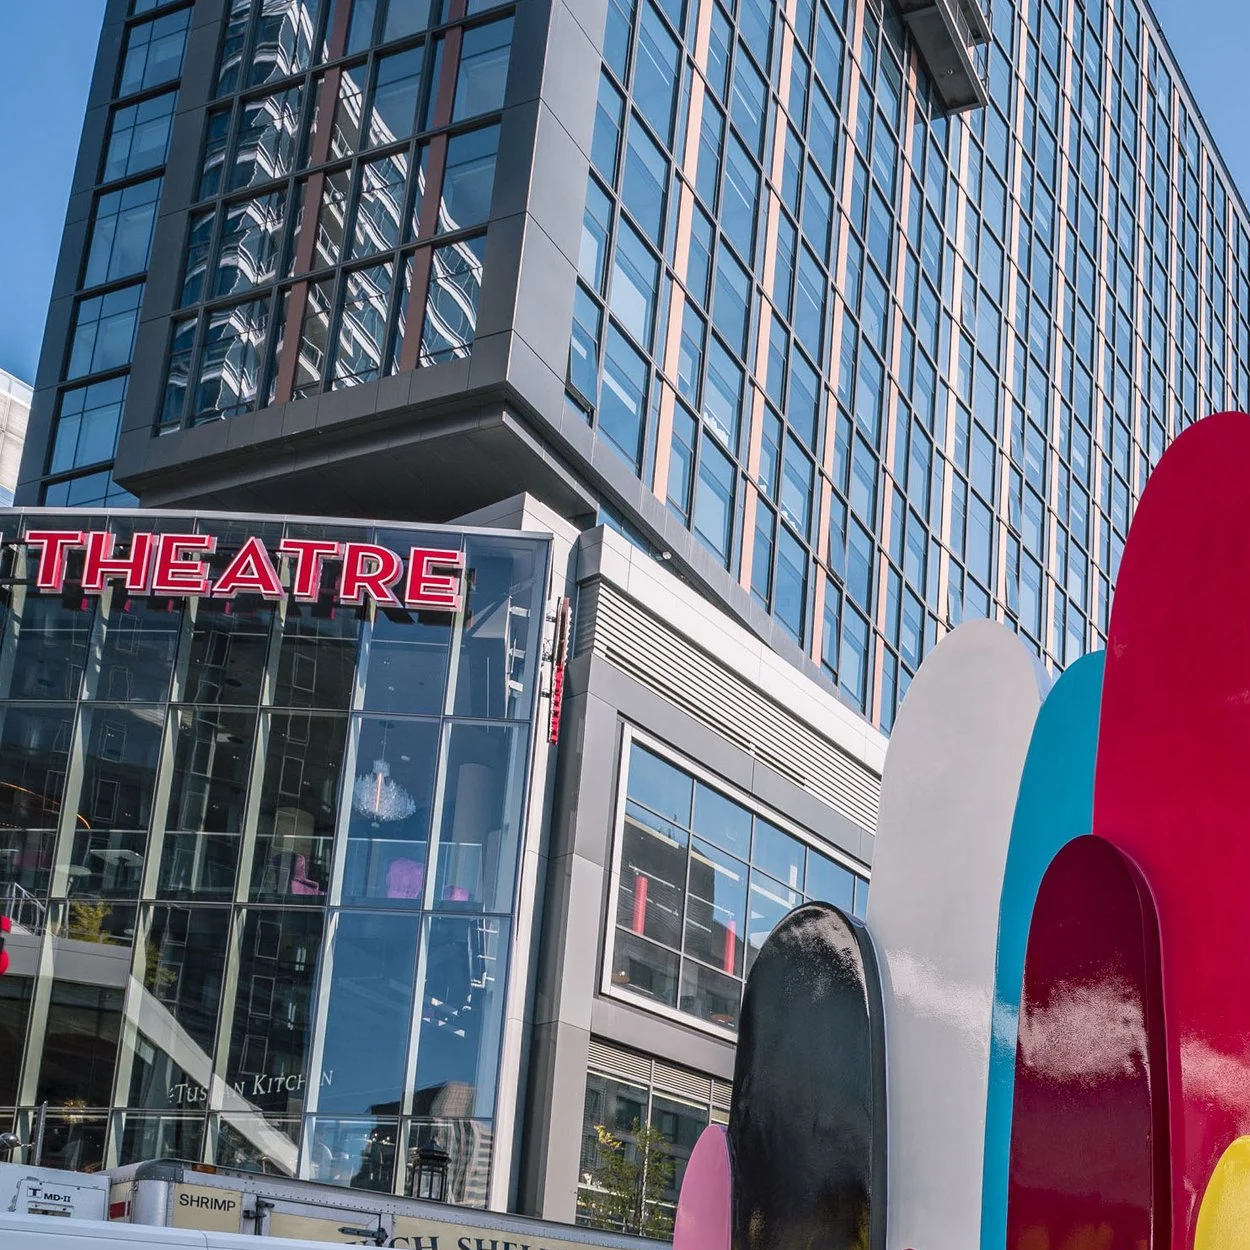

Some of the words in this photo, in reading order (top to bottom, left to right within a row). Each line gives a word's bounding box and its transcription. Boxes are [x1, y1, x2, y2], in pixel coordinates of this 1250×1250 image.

[24, 530, 464, 608] THEATRE
[175, 1081, 246, 1104] TUSN
[252, 1070, 334, 1096] KITCHN
[179, 1193, 236, 1212] SHRIMP
